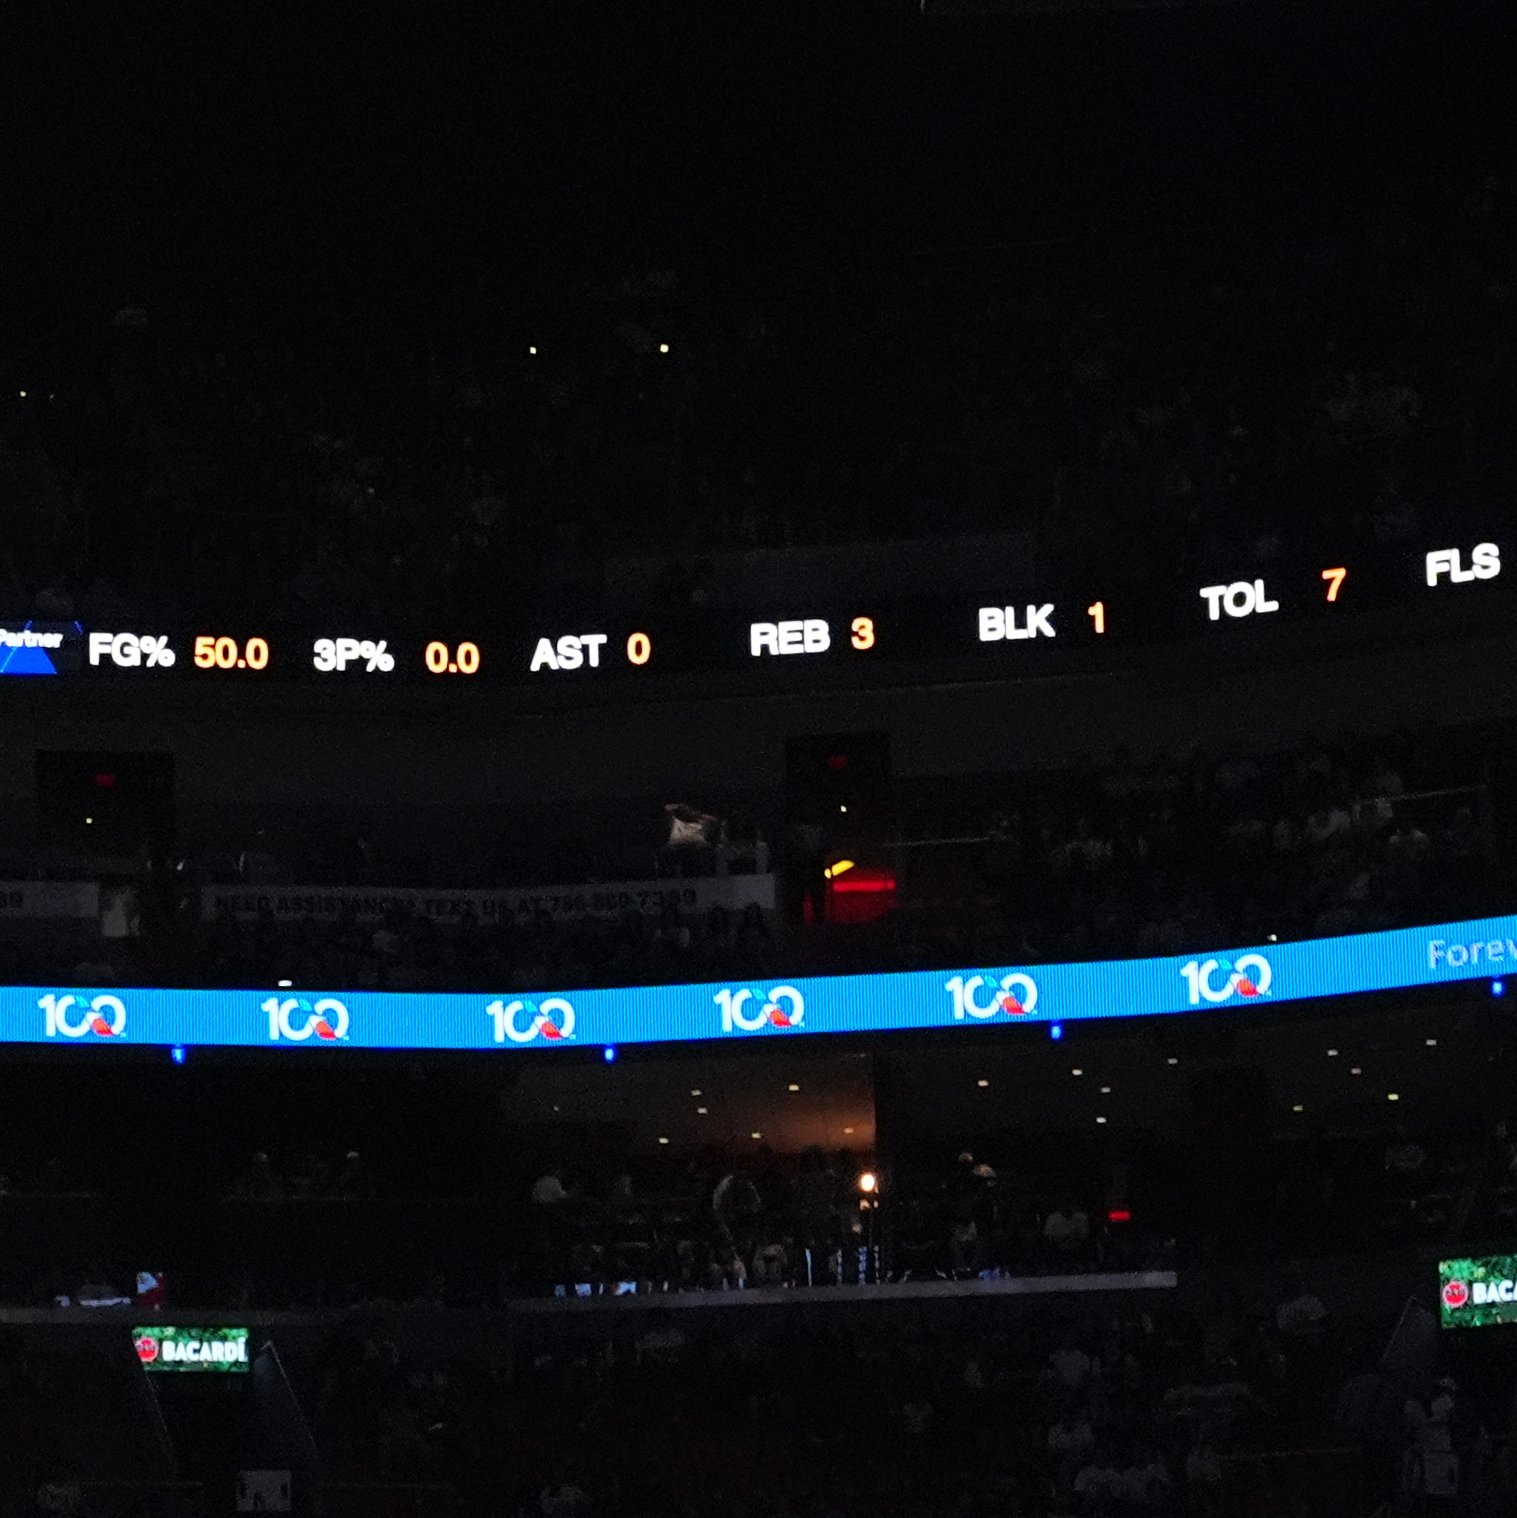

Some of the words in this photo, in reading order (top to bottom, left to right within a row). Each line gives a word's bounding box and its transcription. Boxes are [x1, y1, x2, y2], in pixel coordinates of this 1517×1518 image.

[1424, 543, 1500, 586] FLS
[1199, 578, 1278, 620] TOL
[1322, 567, 1346, 601] 7
[749, 620, 830, 656] REB
[850, 616, 875, 650] 3
[978, 603, 1055, 641] BLK
[1088, 601, 1106, 634] 1
[89, 632, 176, 668] FG%
[194, 635, 269, 670] 50.0
[312, 637, 395, 672] 3P%
[424, 639, 480, 674] 0.0
[529, 634, 608, 672] AST
[626, 632, 652, 666] 0
[945, 973, 1037, 1020] 100
[1179, 953, 1272, 1004] 100
[37, 994, 126, 1038] 100
[261, 997, 350, 1042] 100
[486, 998, 575, 1043] 100
[713, 986, 805, 1033] 100
[162, 1336, 248, 1362] BACARDÍ
